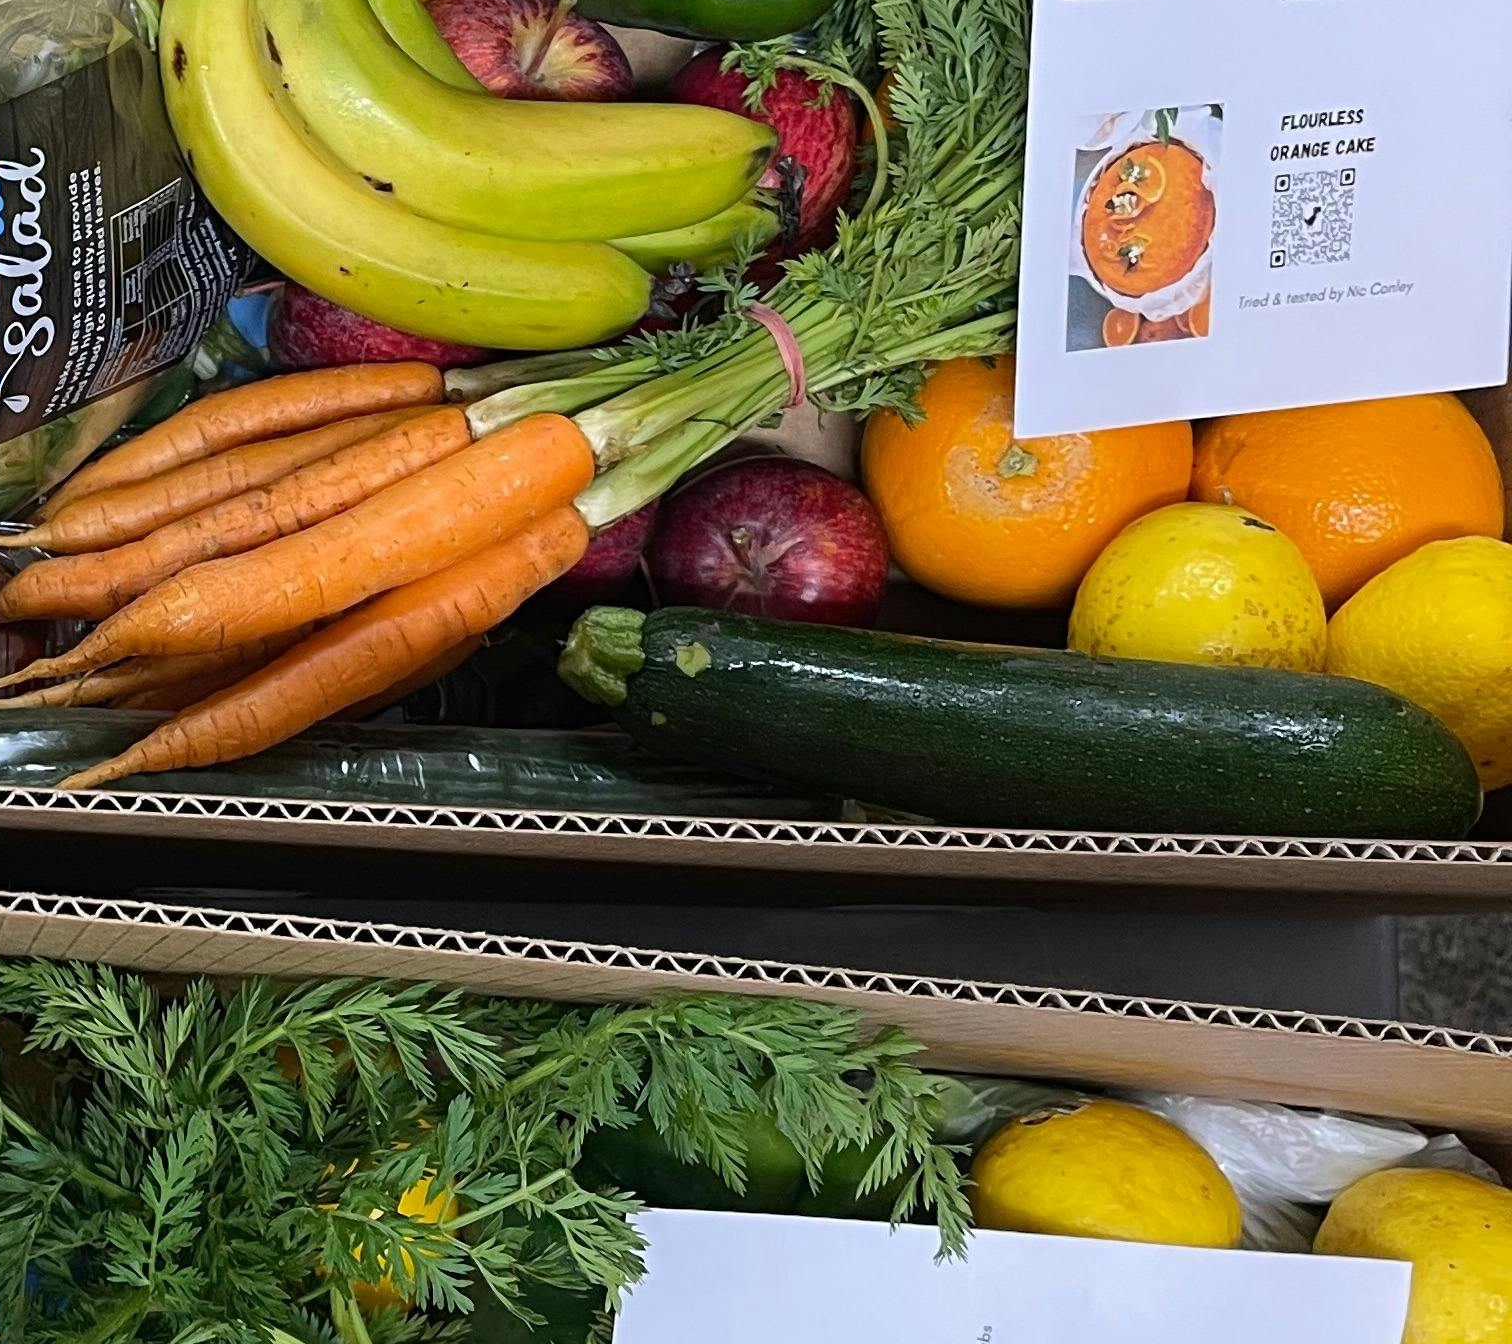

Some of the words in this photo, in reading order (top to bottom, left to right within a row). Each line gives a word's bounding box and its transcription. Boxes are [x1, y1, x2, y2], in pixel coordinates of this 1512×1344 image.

[1281, 109, 1364, 131] FLOURLESS
[1270, 141, 1330, 161] ORANGE
[1336, 137, 1376, 155] CAKE
[69, 172, 82, 242] provide
[80, 169, 94, 238] washed
[93, 161, 104, 223] leaves.
[72, 246, 81, 266] to
[96, 227, 106, 274] salad
[73, 270, 82, 308] care
[84, 241, 95, 307] quality,
[98, 278, 106, 308] use
[1239, 293, 1270, 309] Tried
[1272, 293, 1281, 305] &
[1287, 288, 1326, 304] tested
[1329, 287, 1345, 303] by
[1346, 286, 1367, 298] Nic
[1370, 280, 1414, 296] Conley
[69, 311, 82, 356] great
[81, 310, 95, 349] high
[96, 312, 106, 332] to
[72, 351, 88, 383] with
[85, 335, 105, 377] ready
[54, 360, 73, 391] take
[42, 394, 59, 418] We
[57, 385, 74, 411] you
